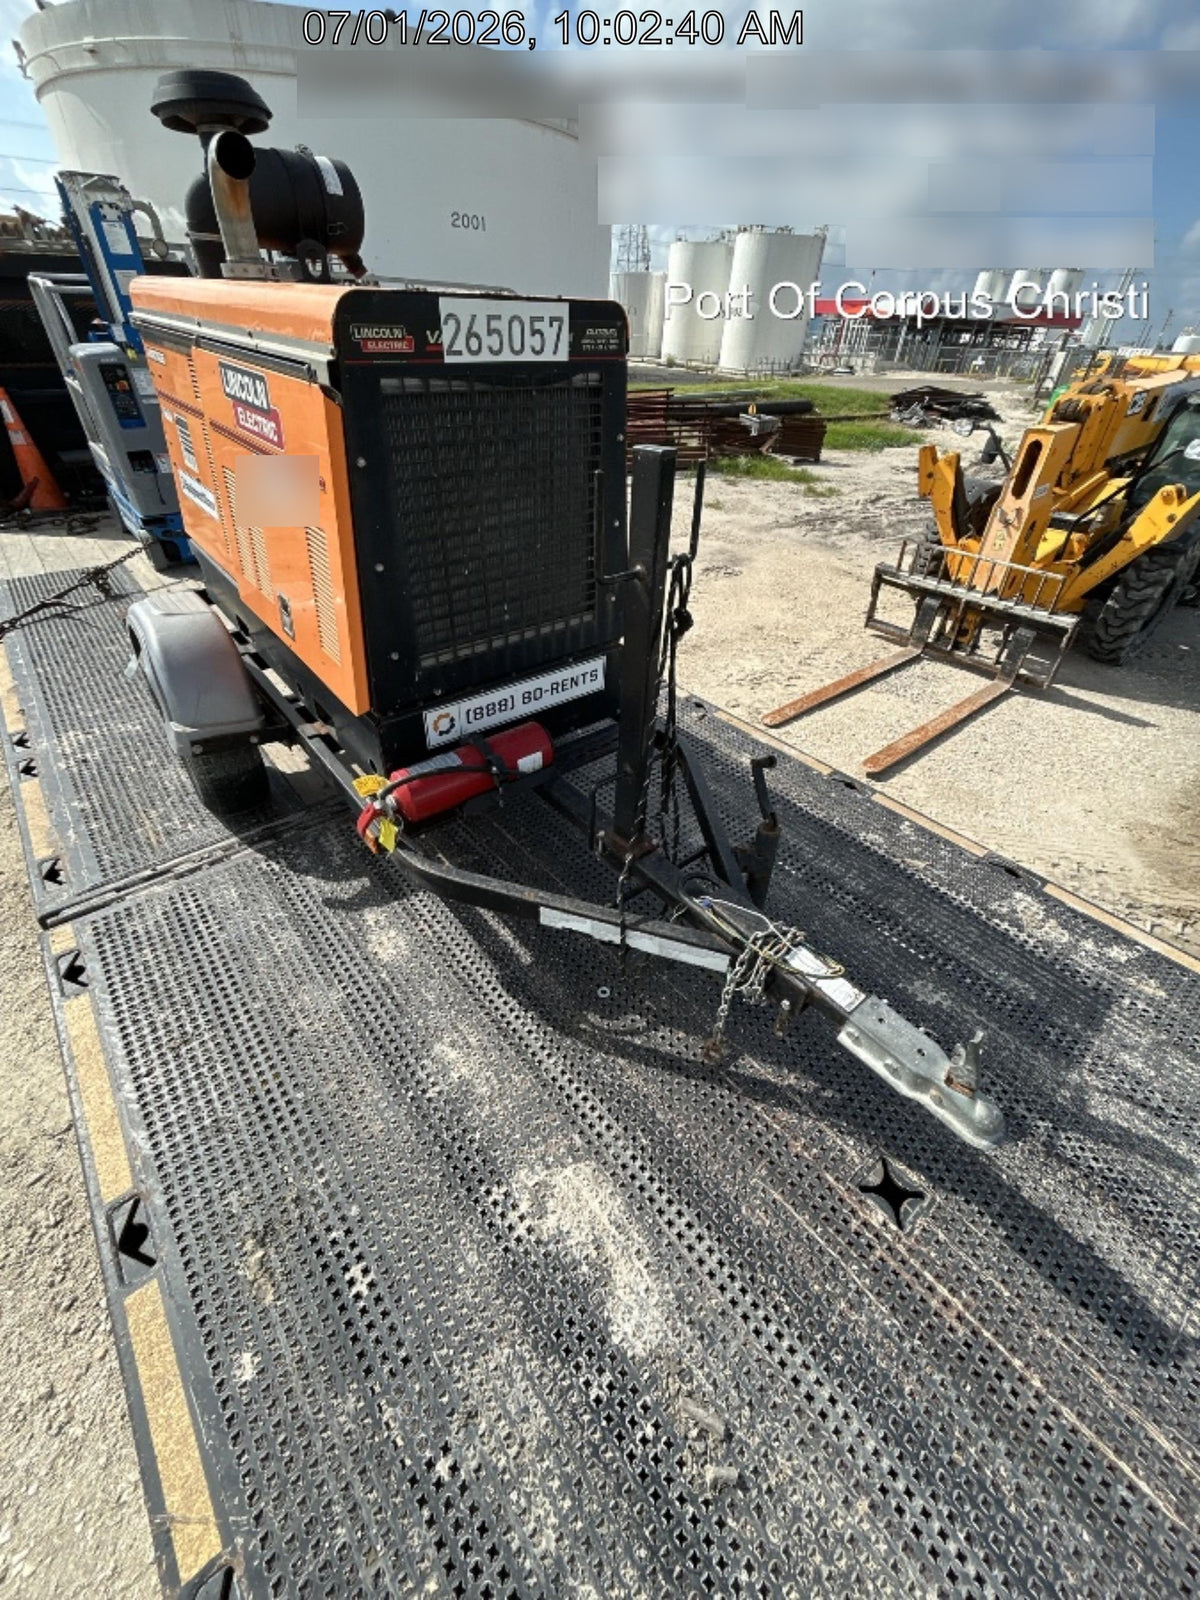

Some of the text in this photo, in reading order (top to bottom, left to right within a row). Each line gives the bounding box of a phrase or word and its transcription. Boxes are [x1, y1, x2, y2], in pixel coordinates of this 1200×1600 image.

[450, 211, 486, 232] 2001
[354, 326, 403, 339] LINCOLN
[443, 313, 564, 356] 265057
[221, 367, 269, 409] LINCOLN
[237, 406, 279, 442] ELECTRIC
